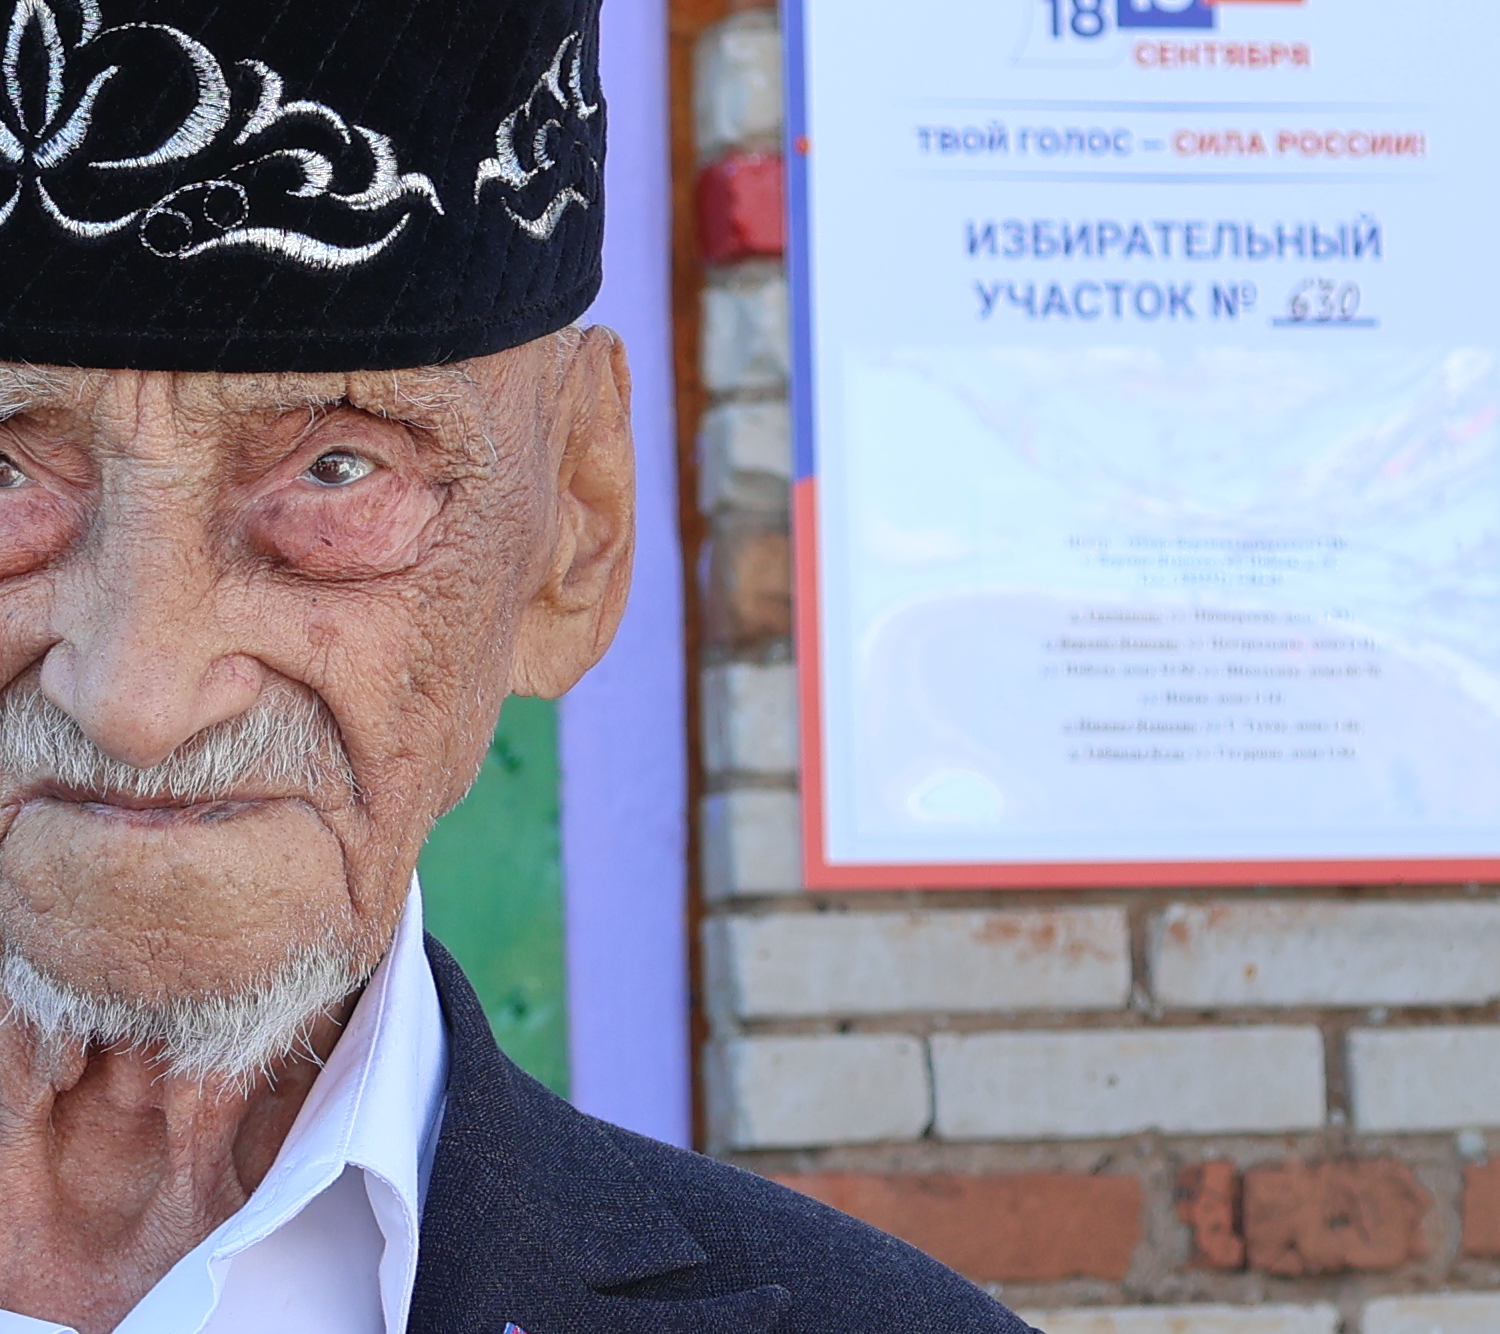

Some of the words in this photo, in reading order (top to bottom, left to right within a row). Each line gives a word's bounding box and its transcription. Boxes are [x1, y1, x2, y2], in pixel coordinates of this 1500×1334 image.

[1134, 42, 1309, 67] СЕНТЯБРЯ
[918, 122, 1008, 153] ТВОЙ
[1018, 128, 1129, 156] ГОЛОС
[1174, 131, 1265, 155] СИЛА
[1277, 131, 1424, 155] РОССИИ!
[967, 215, 1382, 260] ИЗБИРАТЕЛЬНЫЙ
[975, 281, 1194, 320] УЧАСТОК
